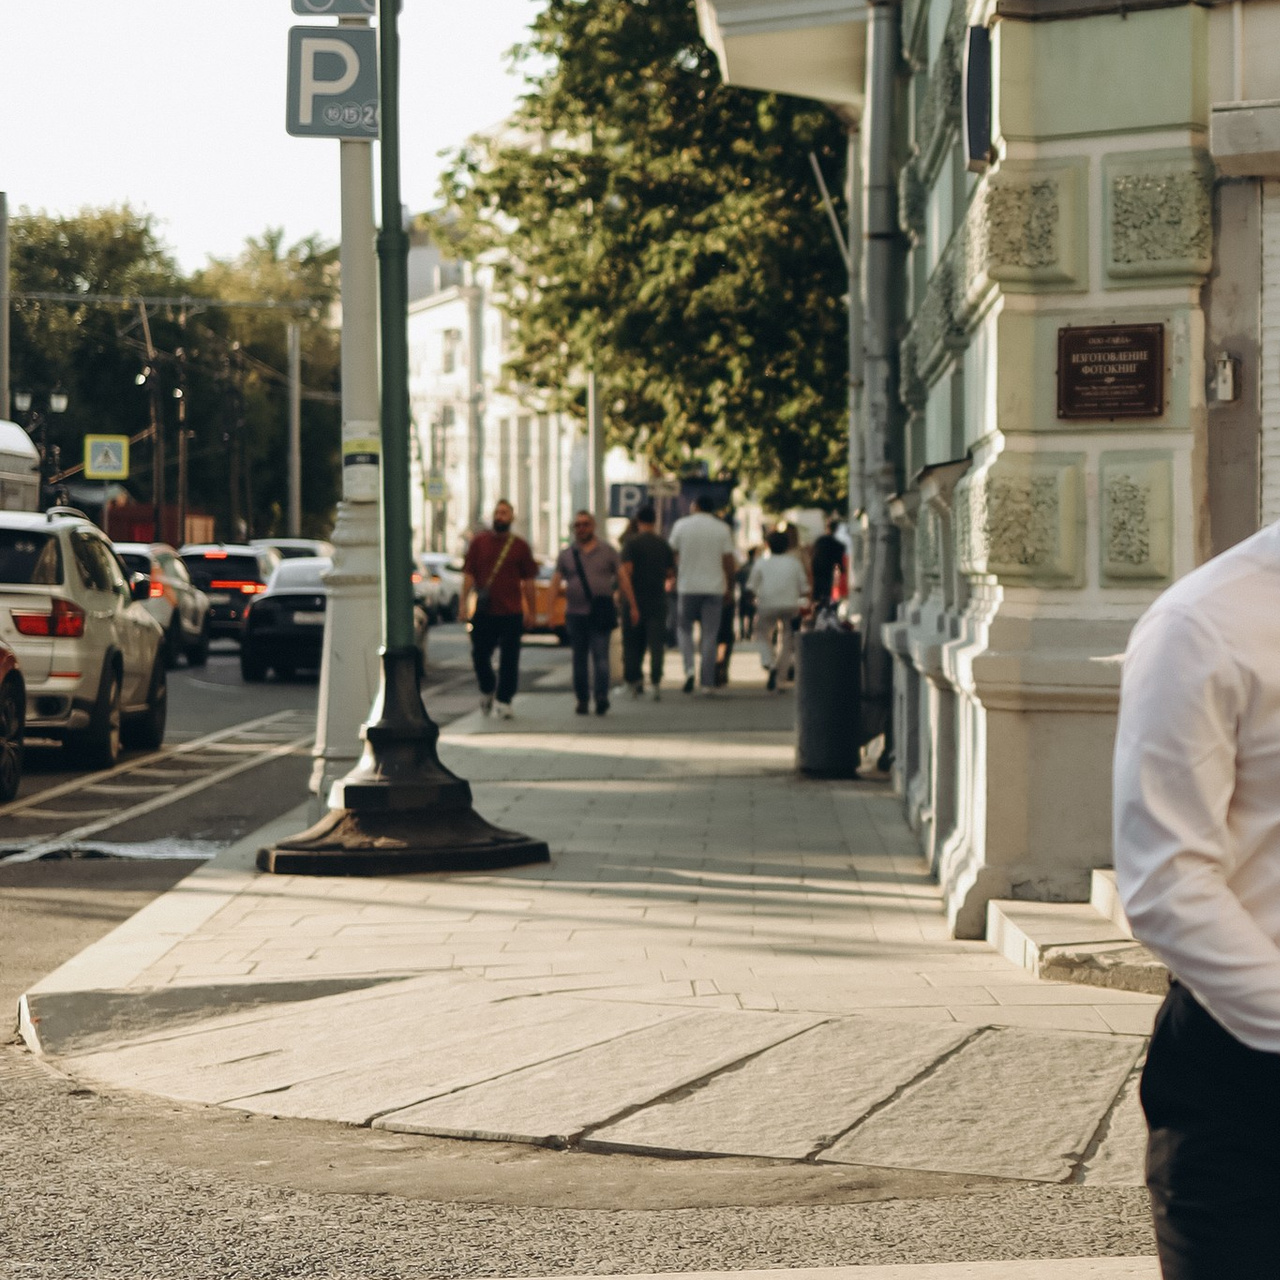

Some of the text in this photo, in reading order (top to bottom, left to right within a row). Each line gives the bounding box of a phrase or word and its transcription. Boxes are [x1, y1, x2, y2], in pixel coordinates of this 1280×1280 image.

[299, 37, 360, 125] P
[344, 107, 358, 123] 15
[1071, 351, 1149, 363] ИЗГОТОВЛЕНИЕ
[1081, 363, 1138, 375] ФОТОКНИГ
[619, 486, 641, 515] P
